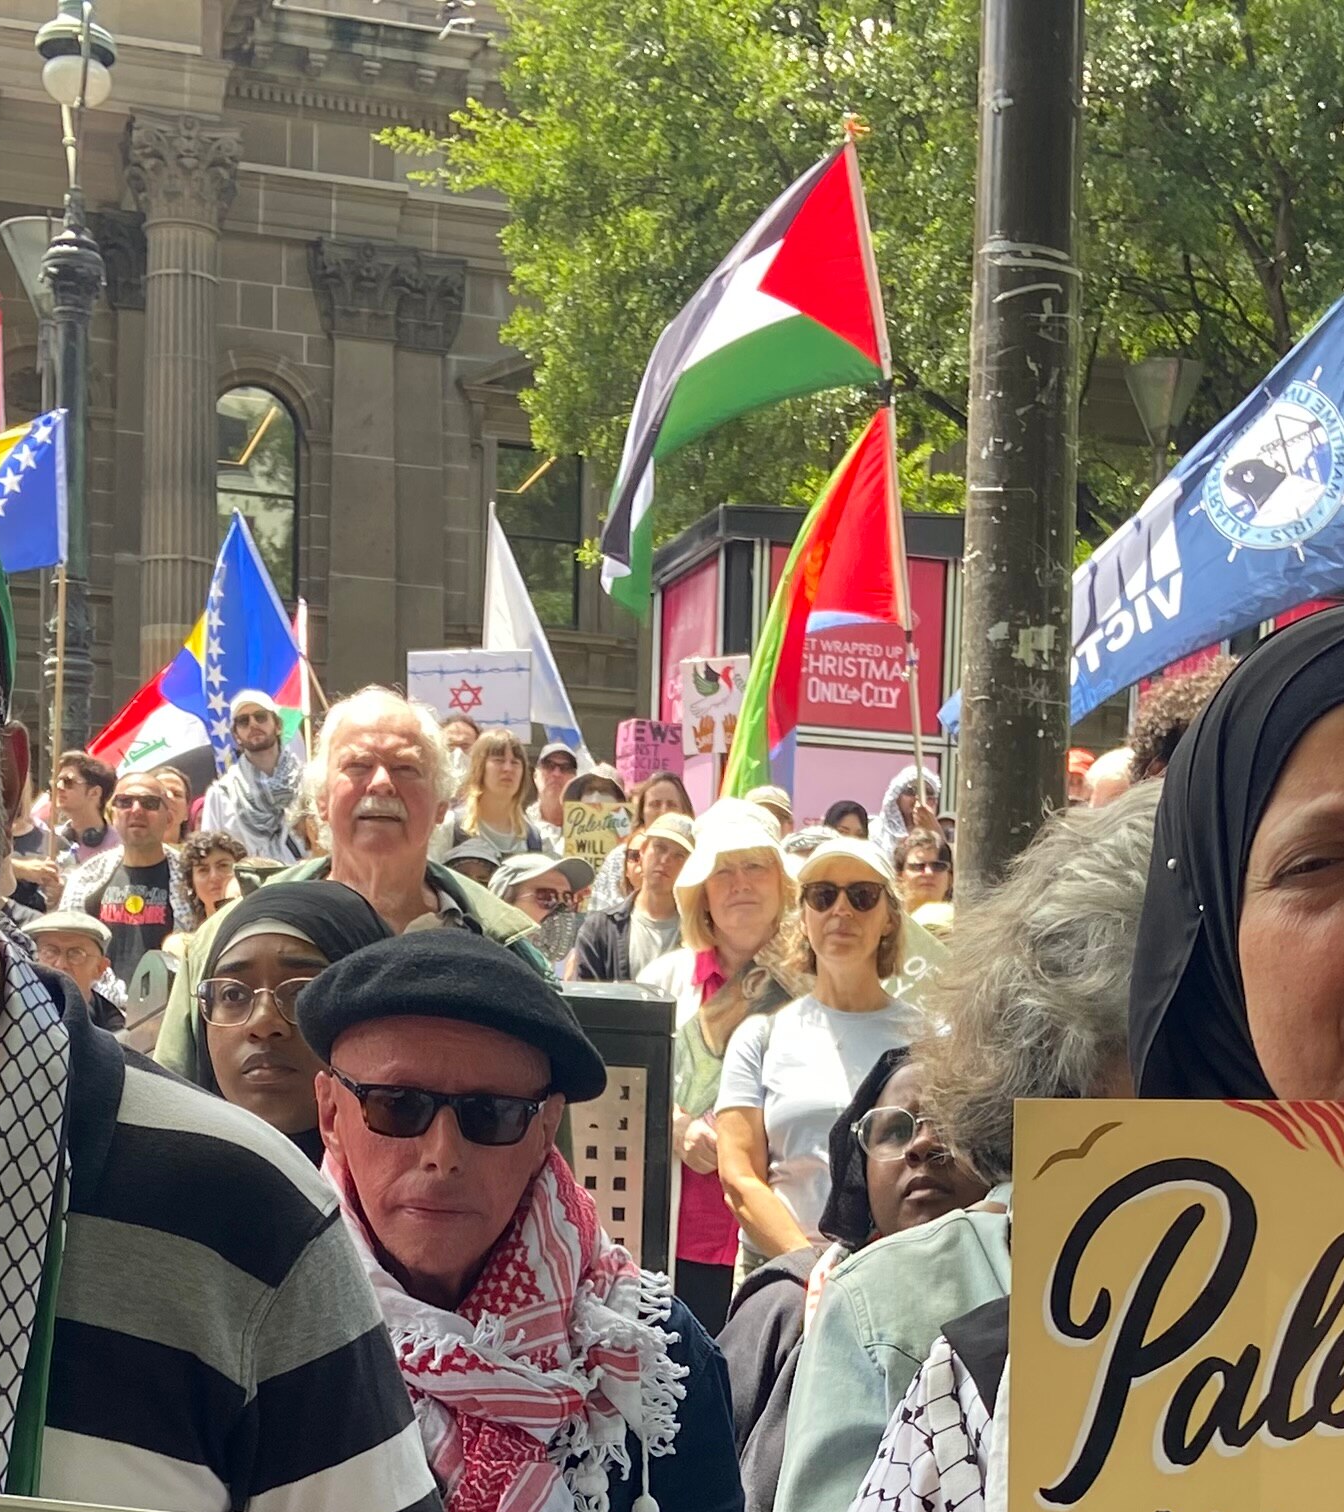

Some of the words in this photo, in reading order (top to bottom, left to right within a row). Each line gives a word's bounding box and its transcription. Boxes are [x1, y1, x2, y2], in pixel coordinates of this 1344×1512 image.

[820, 639, 883, 657] WRAPPED
[886, 646, 904, 659] UP
[801, 653, 909, 682] HRISTMA
[622, 721, 683, 745] JEWS
[567, 806, 630, 839] Palestine
[575, 838, 605, 853] WILL
